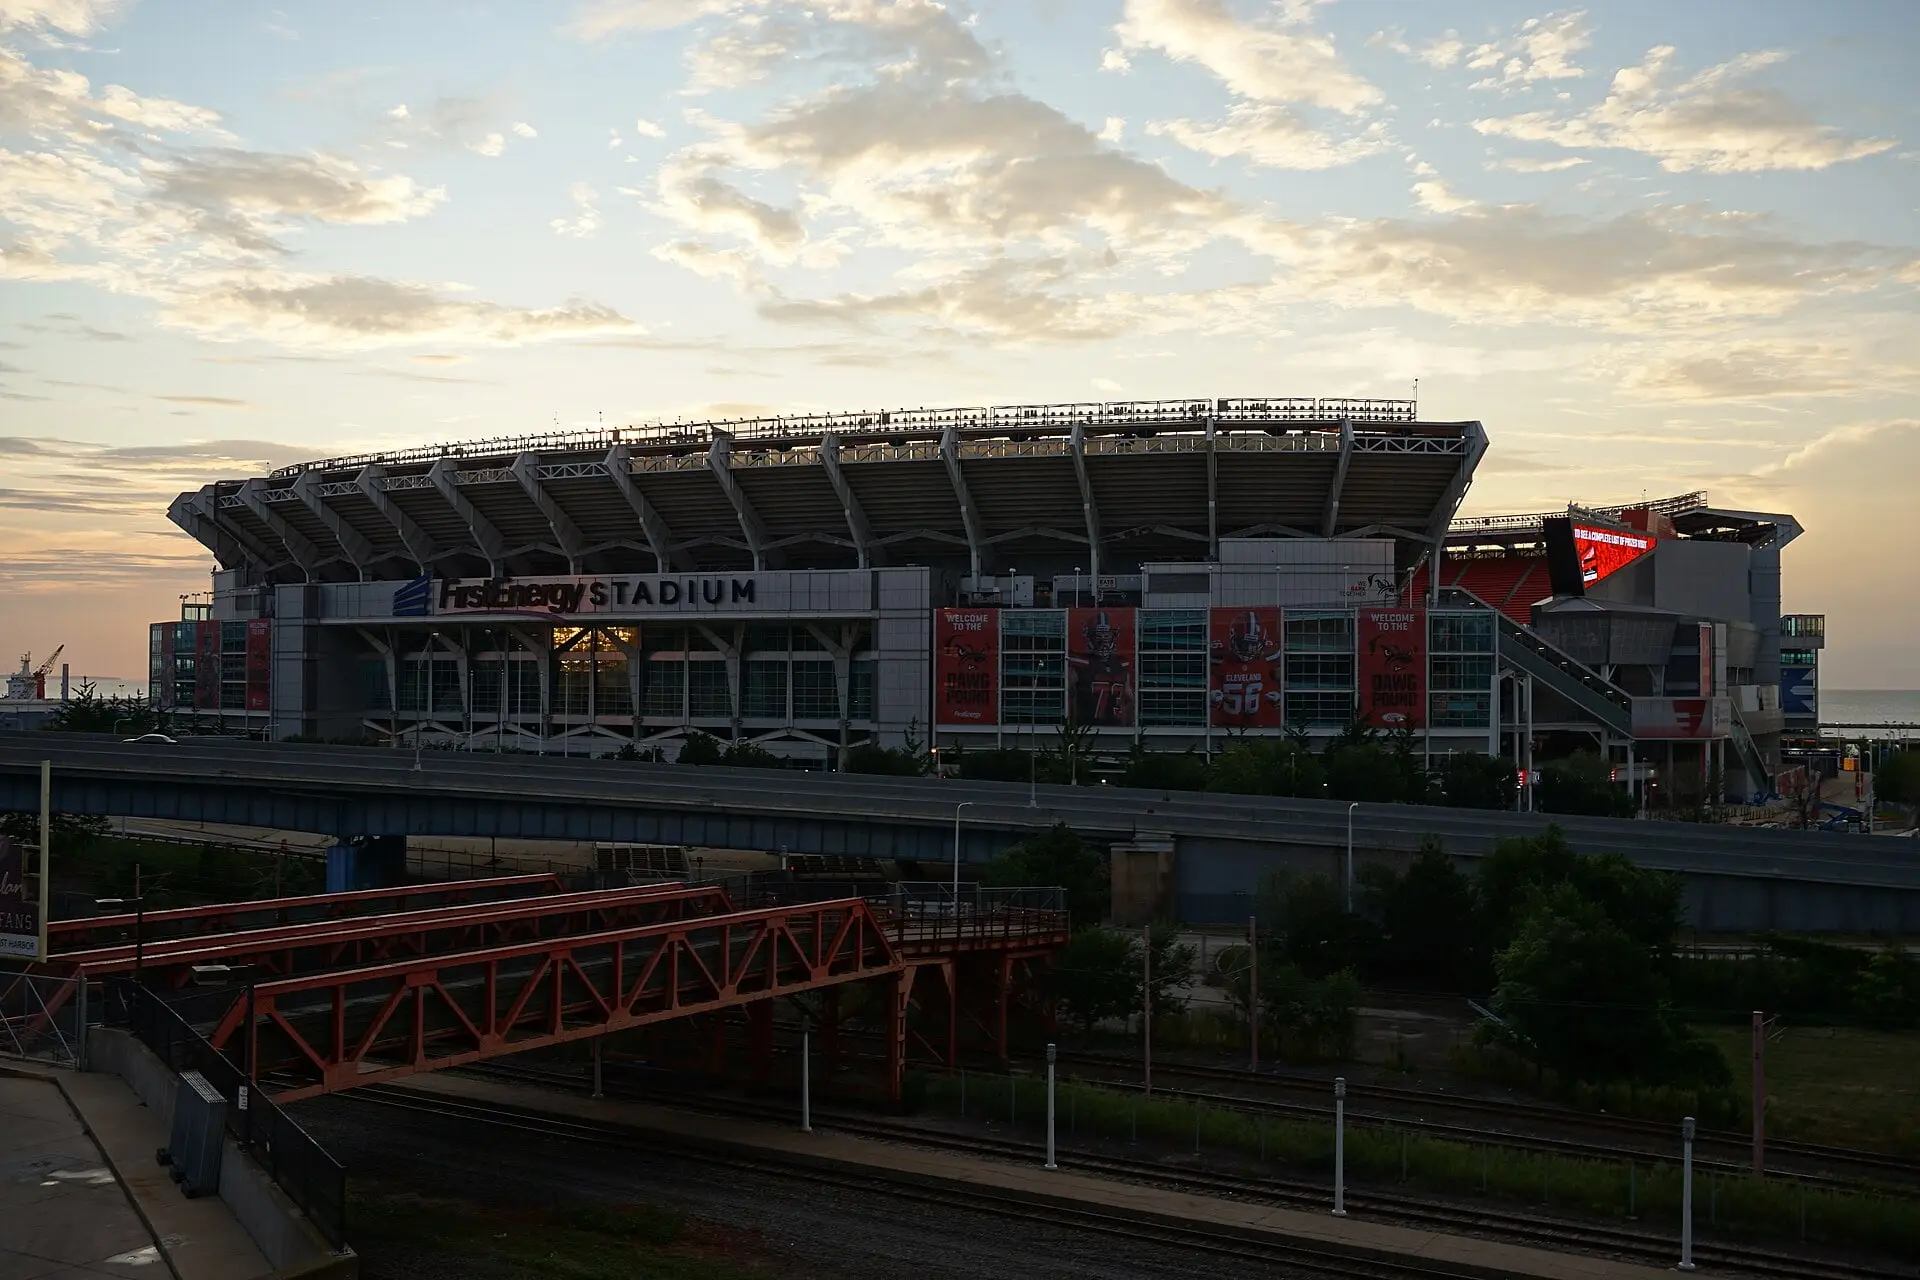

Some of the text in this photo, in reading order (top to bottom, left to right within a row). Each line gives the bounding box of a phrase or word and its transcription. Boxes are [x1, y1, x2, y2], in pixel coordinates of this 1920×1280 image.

[438, 576, 755, 613] FirstEnergy STADIUM
[946, 614, 989, 623] WELCOME
[1371, 612, 1416, 622] WELCOME
[953, 622, 982, 631] TO THE
[1378, 622, 1409, 631] TO THE
[947, 672, 990, 690] DAWG
[1225, 673, 1262, 682] CLEVELAND
[1372, 674, 1417, 692] DAWG
[947, 690, 990, 705] POUND
[1223, 682, 1264, 715] 56
[1372, 691, 1417, 708] POUND
[8, 939, 34, 950] HARBOR
